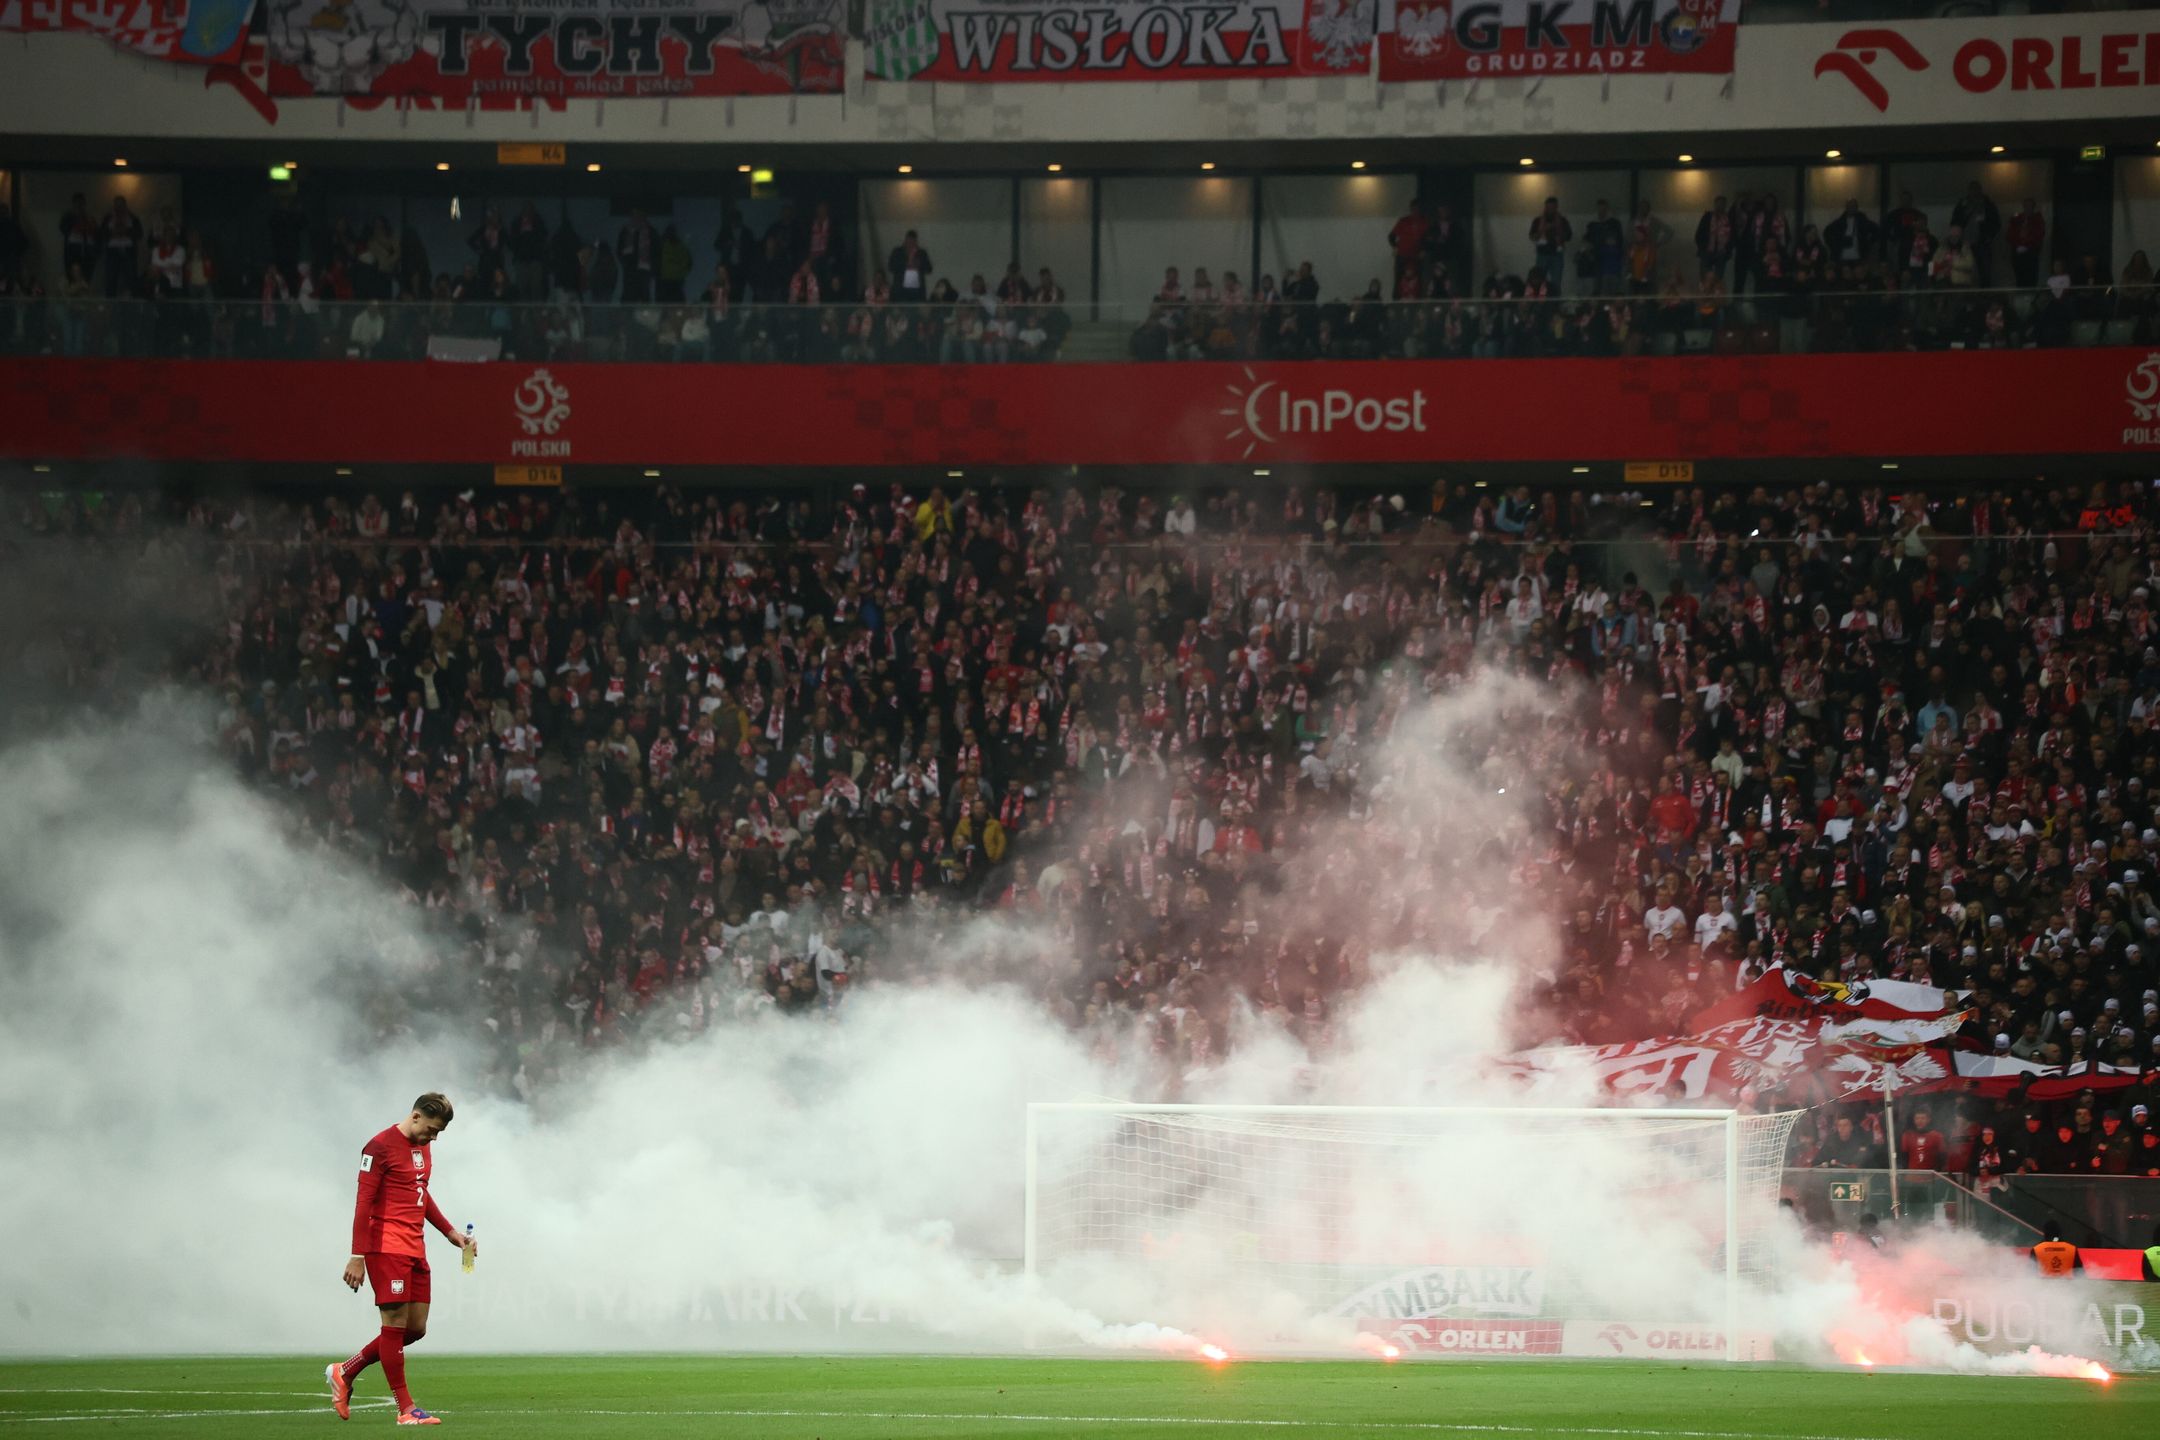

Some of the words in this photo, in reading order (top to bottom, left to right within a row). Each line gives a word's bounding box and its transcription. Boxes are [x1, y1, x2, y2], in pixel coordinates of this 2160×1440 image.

[424, 12, 736, 75] TYCHY
[946, 6, 1290, 71] WISŁOKA
[1465, 51, 1645, 73] GRUDZIĄDZ
[1279, 389, 1427, 433] InPost
[511, 439, 571, 457] POLSKA
[1658, 464, 1689, 478] D15
[416, 1186, 424, 1207] 2
[1440, 1329, 1526, 1349] ORLEN
[1646, 1331, 1728, 1350] ORLEN
